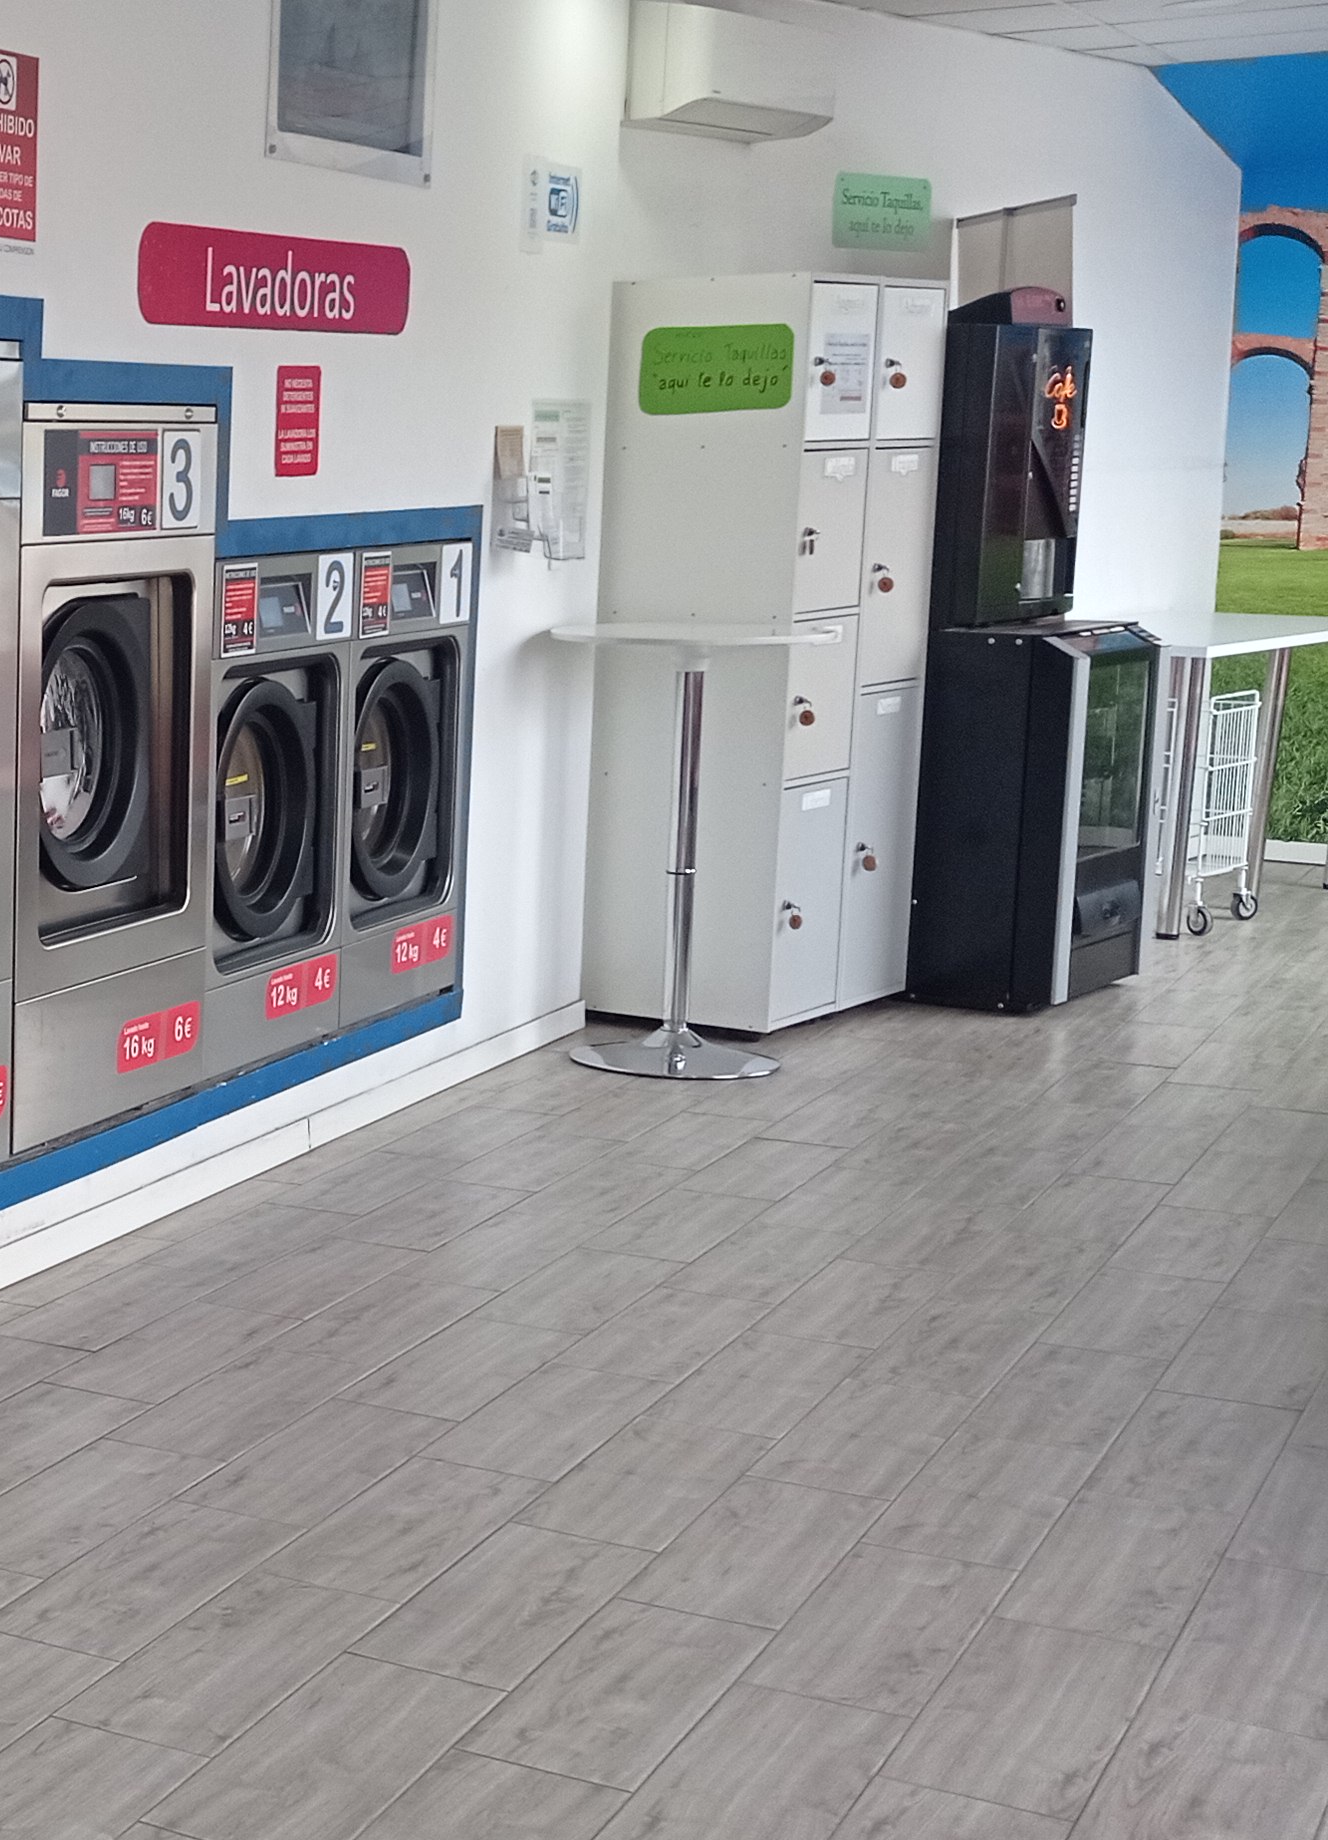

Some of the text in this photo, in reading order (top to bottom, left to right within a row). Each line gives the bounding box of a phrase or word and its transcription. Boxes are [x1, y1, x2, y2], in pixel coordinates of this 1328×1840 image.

[8, 172, 24, 186] TIPO
[205, 246, 355, 320] Lavadoras
[169, 438, 193, 521] 3
[450, 549, 463, 618] 1
[324, 560, 345, 634] 2
[395, 942, 407, 963] 12
[271, 985, 297, 1008] 12 kg
[175, 1016, 192, 1041] 6€
[124, 1035, 155, 1060] 16 kg
